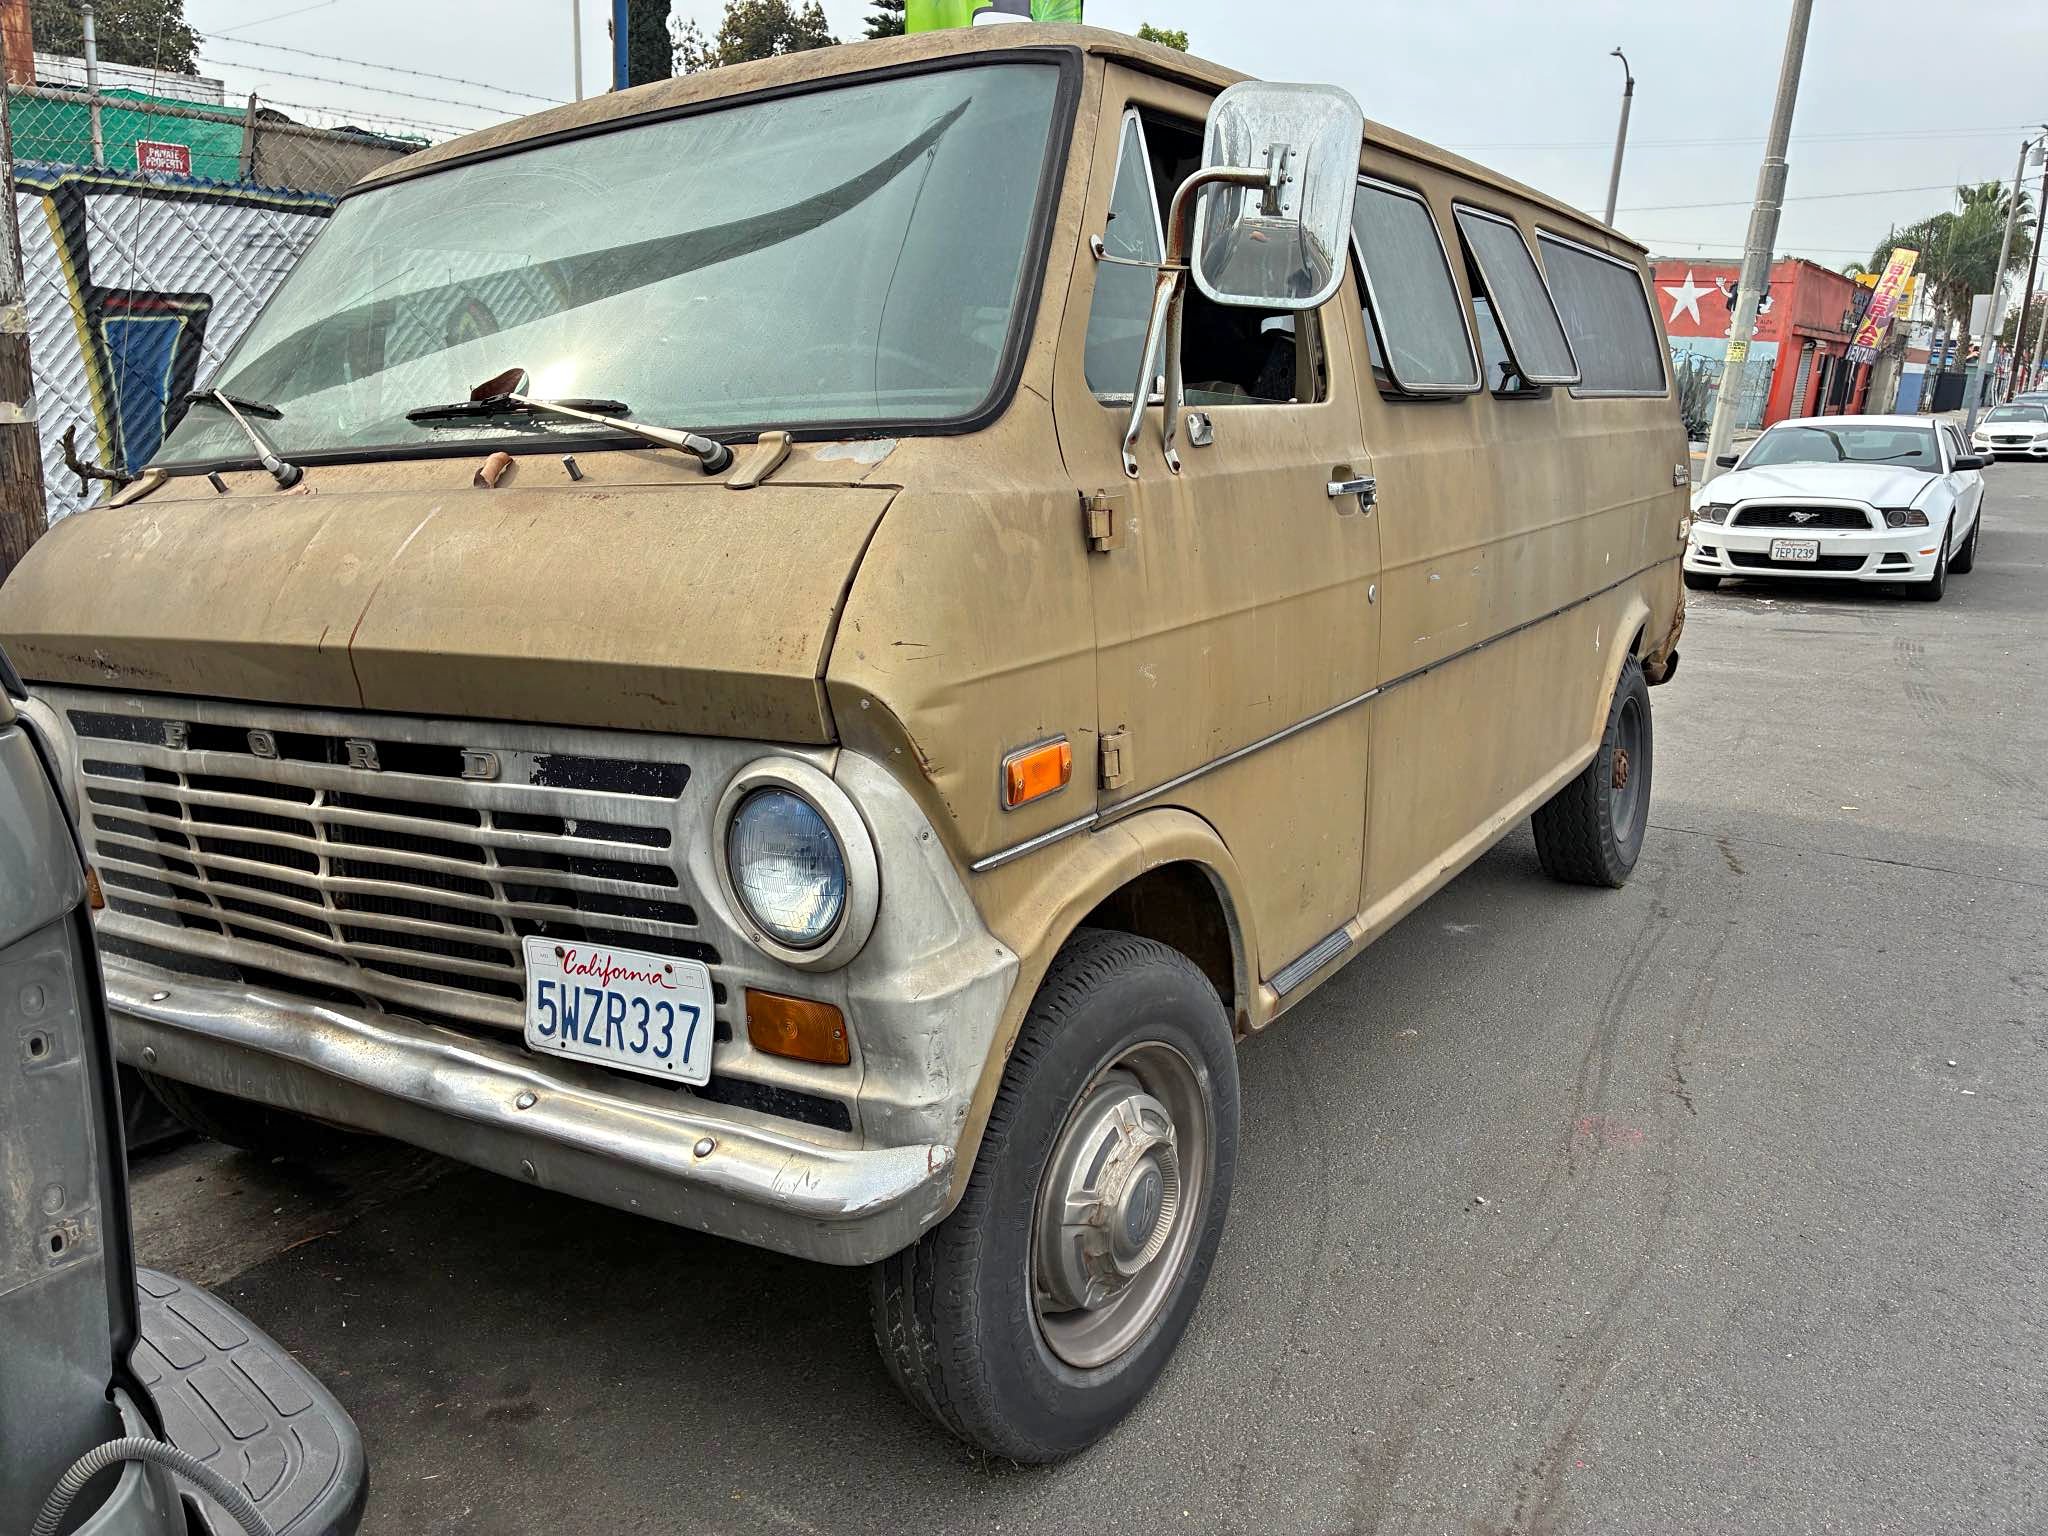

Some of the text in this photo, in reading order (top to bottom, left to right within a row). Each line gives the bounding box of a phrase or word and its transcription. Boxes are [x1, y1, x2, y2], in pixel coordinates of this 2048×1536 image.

[146, 157, 183, 169] PROPERTY
[149, 147, 180, 159] PRIVATE
[1857, 264, 1904, 347] BATERIAS
[1775, 547, 1815, 559] 7EPT239
[161, 720, 500, 780] FORD
[563, 949, 677, 989] California
[537, 979, 701, 1064] 5WZR337
